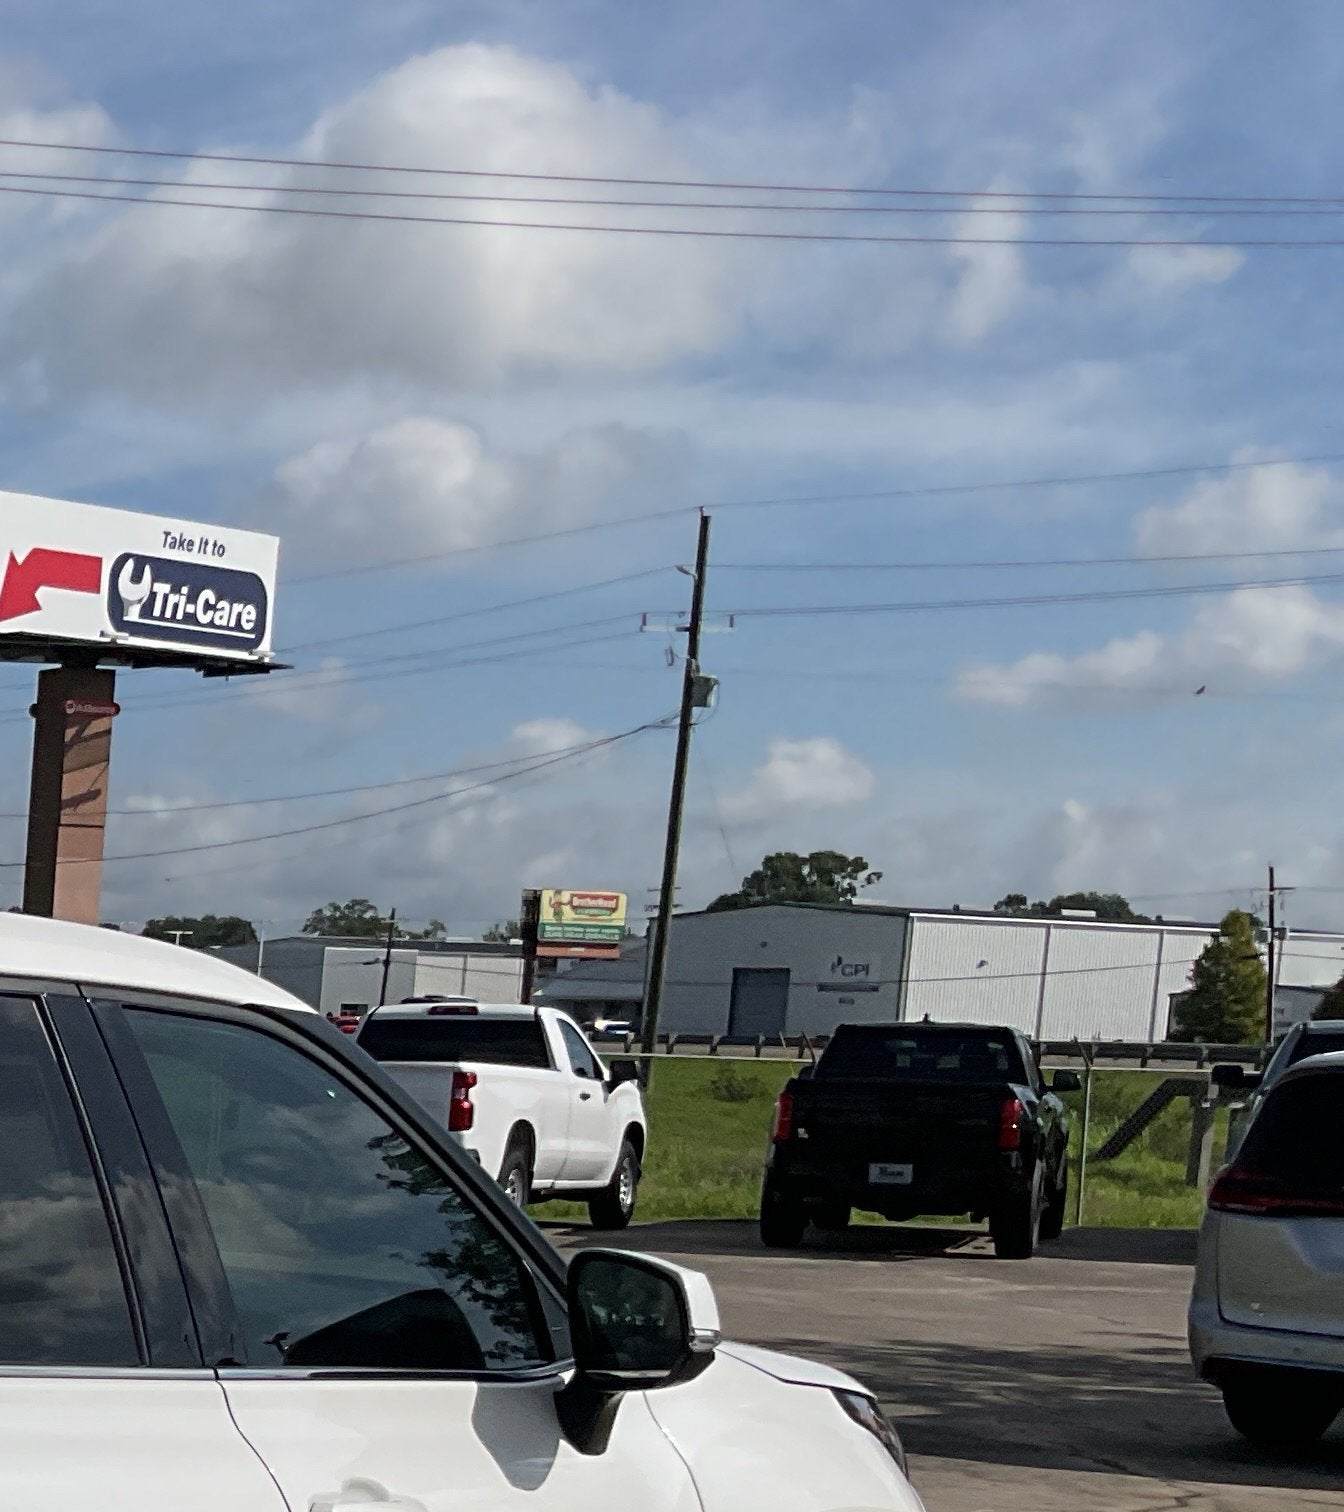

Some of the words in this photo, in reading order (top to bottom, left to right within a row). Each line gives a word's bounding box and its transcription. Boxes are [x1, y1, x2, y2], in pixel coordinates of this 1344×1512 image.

[162, 531, 195, 553] Take
[198, 536, 209, 555] It
[212, 540, 226, 558] to
[152, 582, 257, 631] Tri-Care
